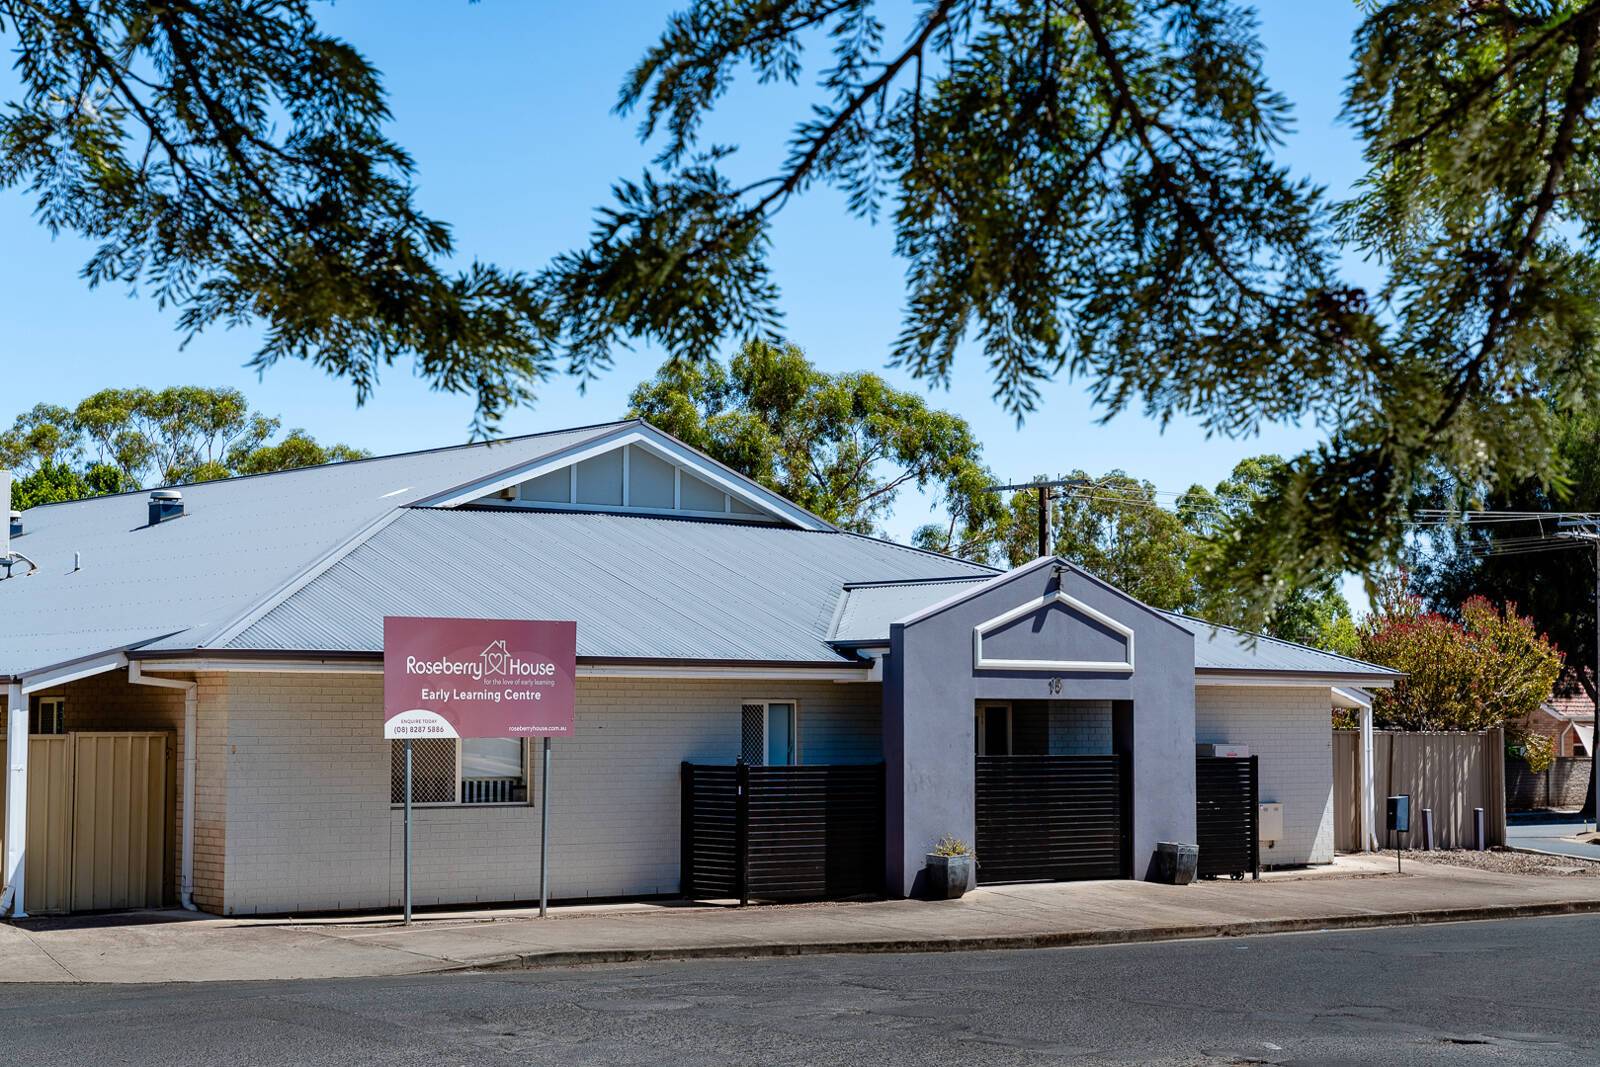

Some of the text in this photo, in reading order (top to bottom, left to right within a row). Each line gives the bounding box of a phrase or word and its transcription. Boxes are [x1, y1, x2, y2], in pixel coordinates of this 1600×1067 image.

[406, 655, 555, 680] Roseberry House
[421, 688, 542, 703] Early Learning Centre
[394, 726, 408, 735] (08)
